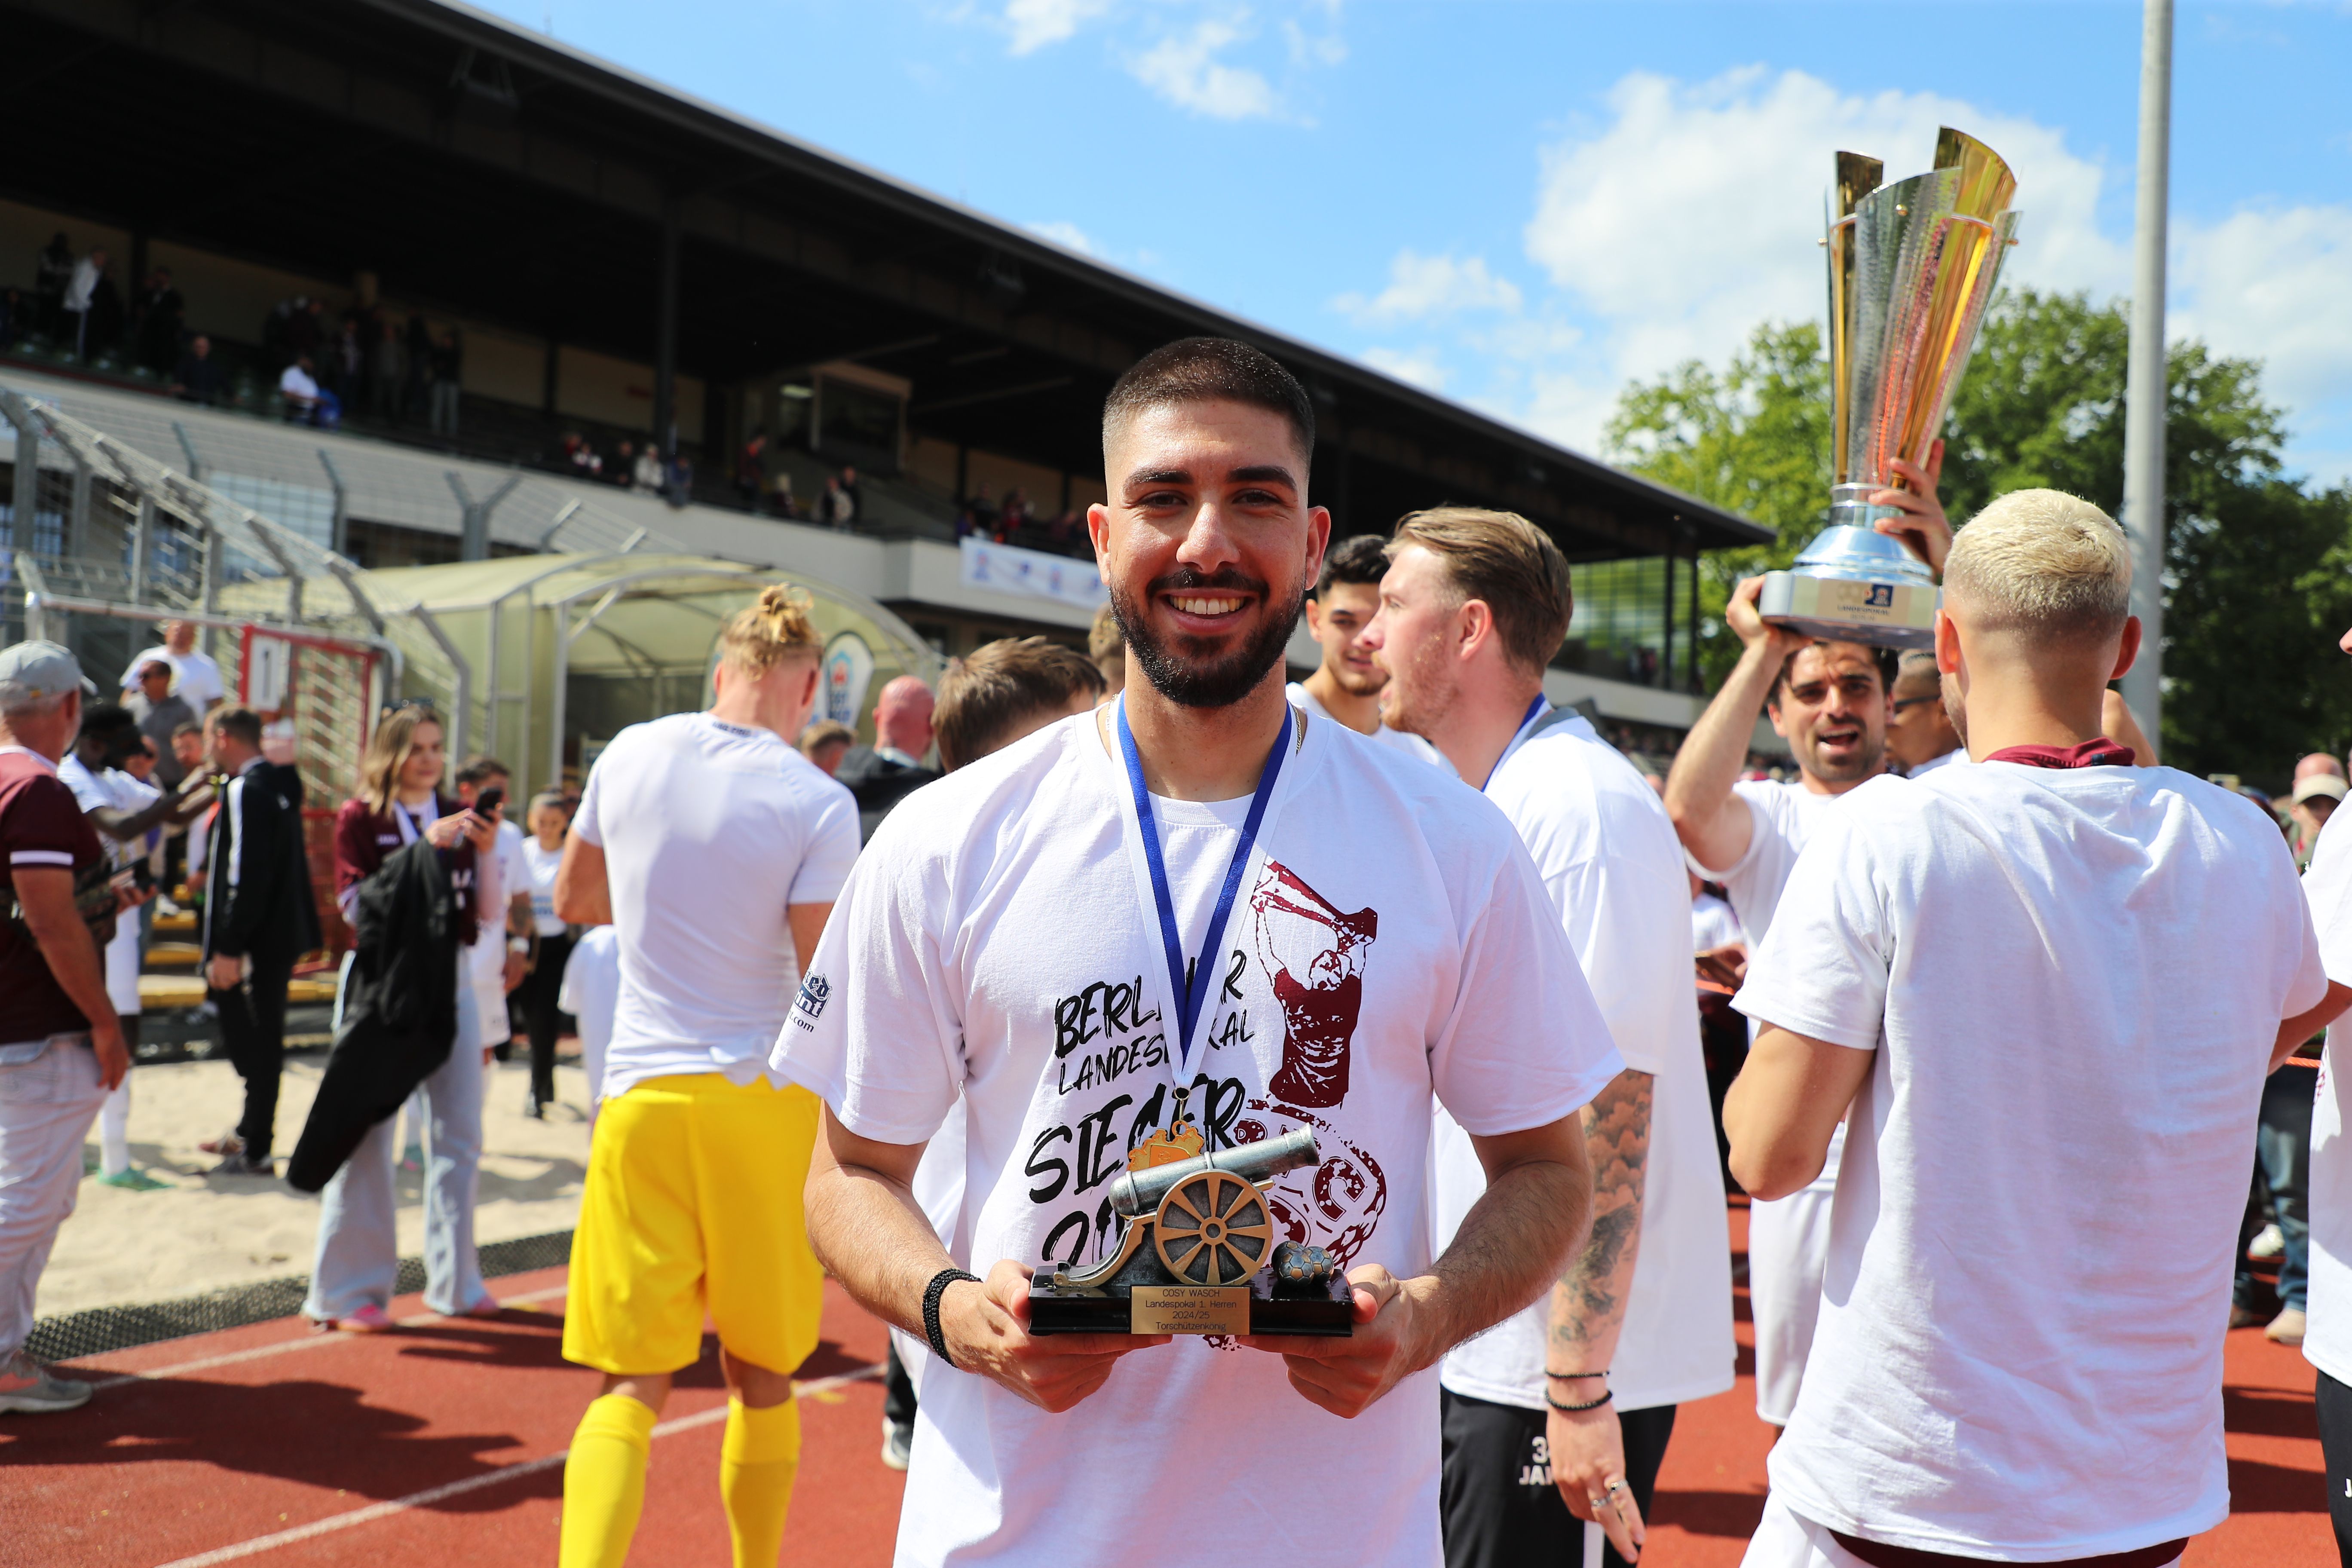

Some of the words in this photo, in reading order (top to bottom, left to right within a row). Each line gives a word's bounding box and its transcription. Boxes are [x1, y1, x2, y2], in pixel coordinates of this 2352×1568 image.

[1055, 949, 1246, 1059] BERLR
[1059, 1009, 1255, 1096] LANDESKAL
[1162, 1289, 1185, 1297] COSY
[1189, 1289, 1220, 1297] WASCH
[1145, 1300, 1195, 1309] Landespokal
[1172, 1311, 1210, 1319] 2024/25
[1156, 1321, 1226, 1331] Torschützenkönig
[1531, 1436, 1550, 1464] 3
